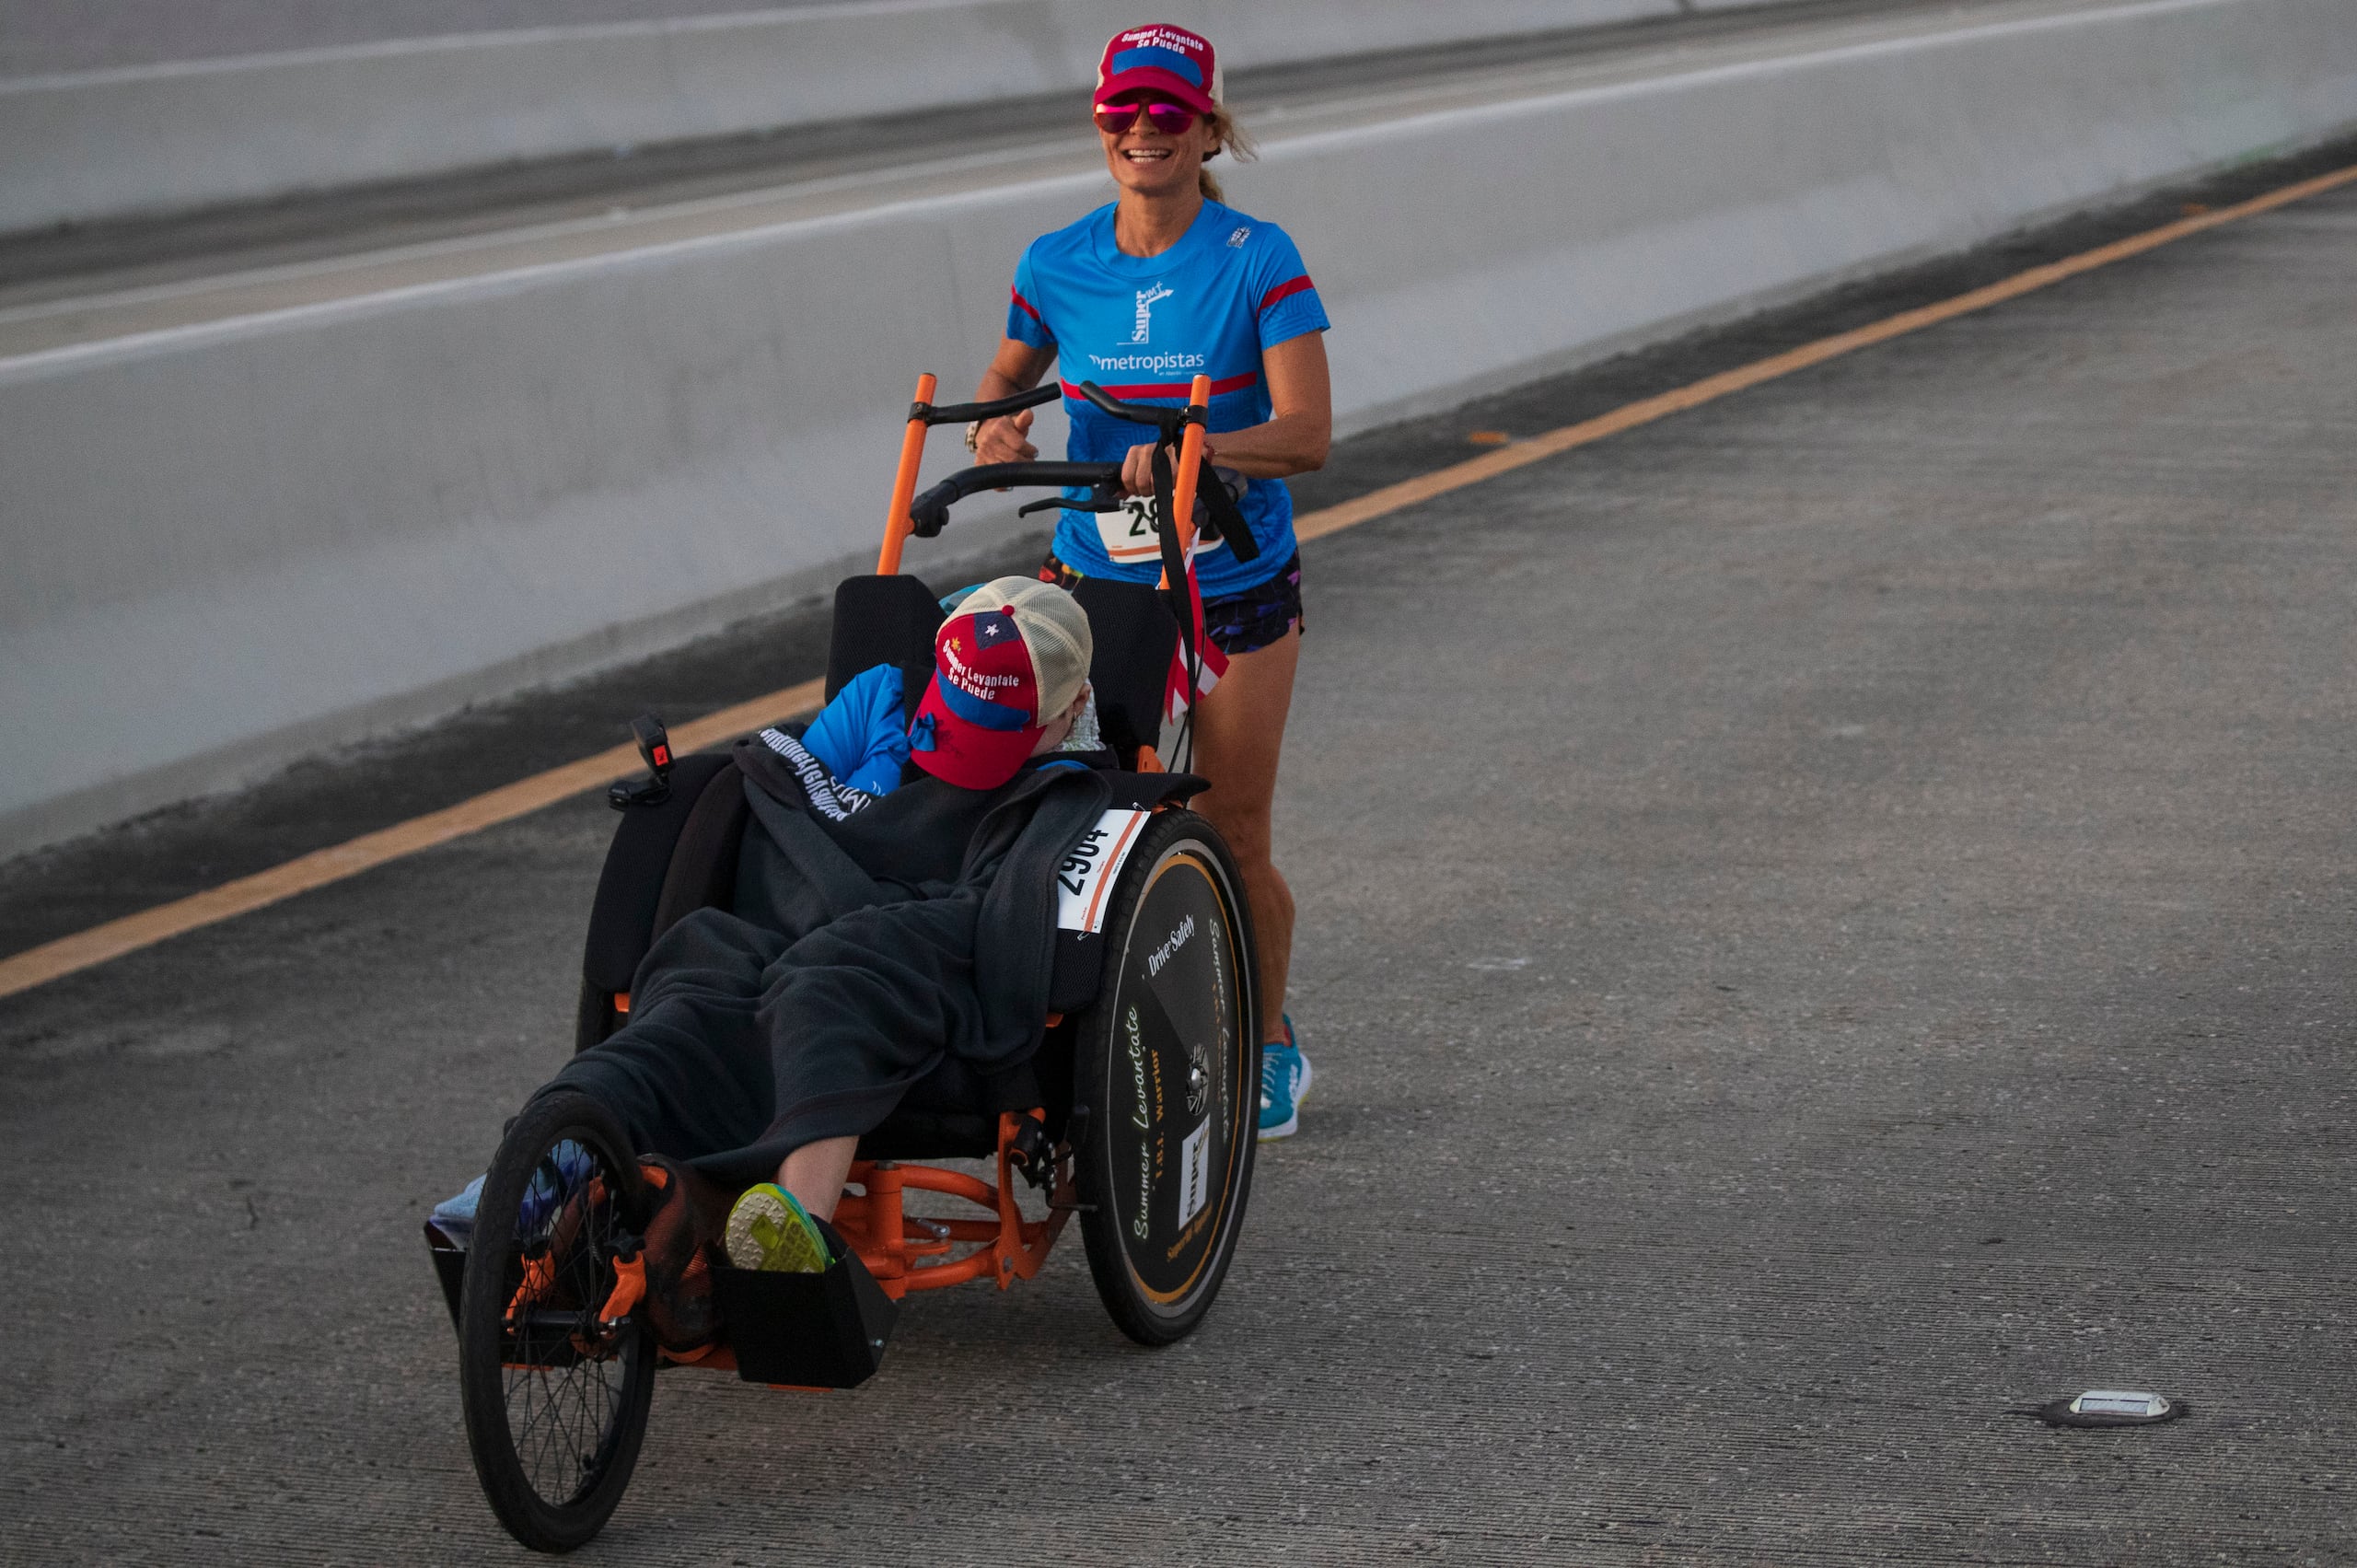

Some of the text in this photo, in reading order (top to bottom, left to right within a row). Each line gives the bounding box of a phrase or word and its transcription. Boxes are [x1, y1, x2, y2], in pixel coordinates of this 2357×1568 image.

[1121, 28, 1204, 52] Summer Levantate
[1136, 36, 1186, 54] Se Puede
[1131, 289, 1151, 342] Super
[1099, 351, 1205, 374] metropistas
[942, 639, 1020, 688] Summer Levantate
[947, 668, 995, 701] Se Puede
[1058, 830, 1109, 897] 2904
[1147, 914, 1196, 979] Drive Safely
[1125, 1005, 1150, 1239] Summer Levantate
